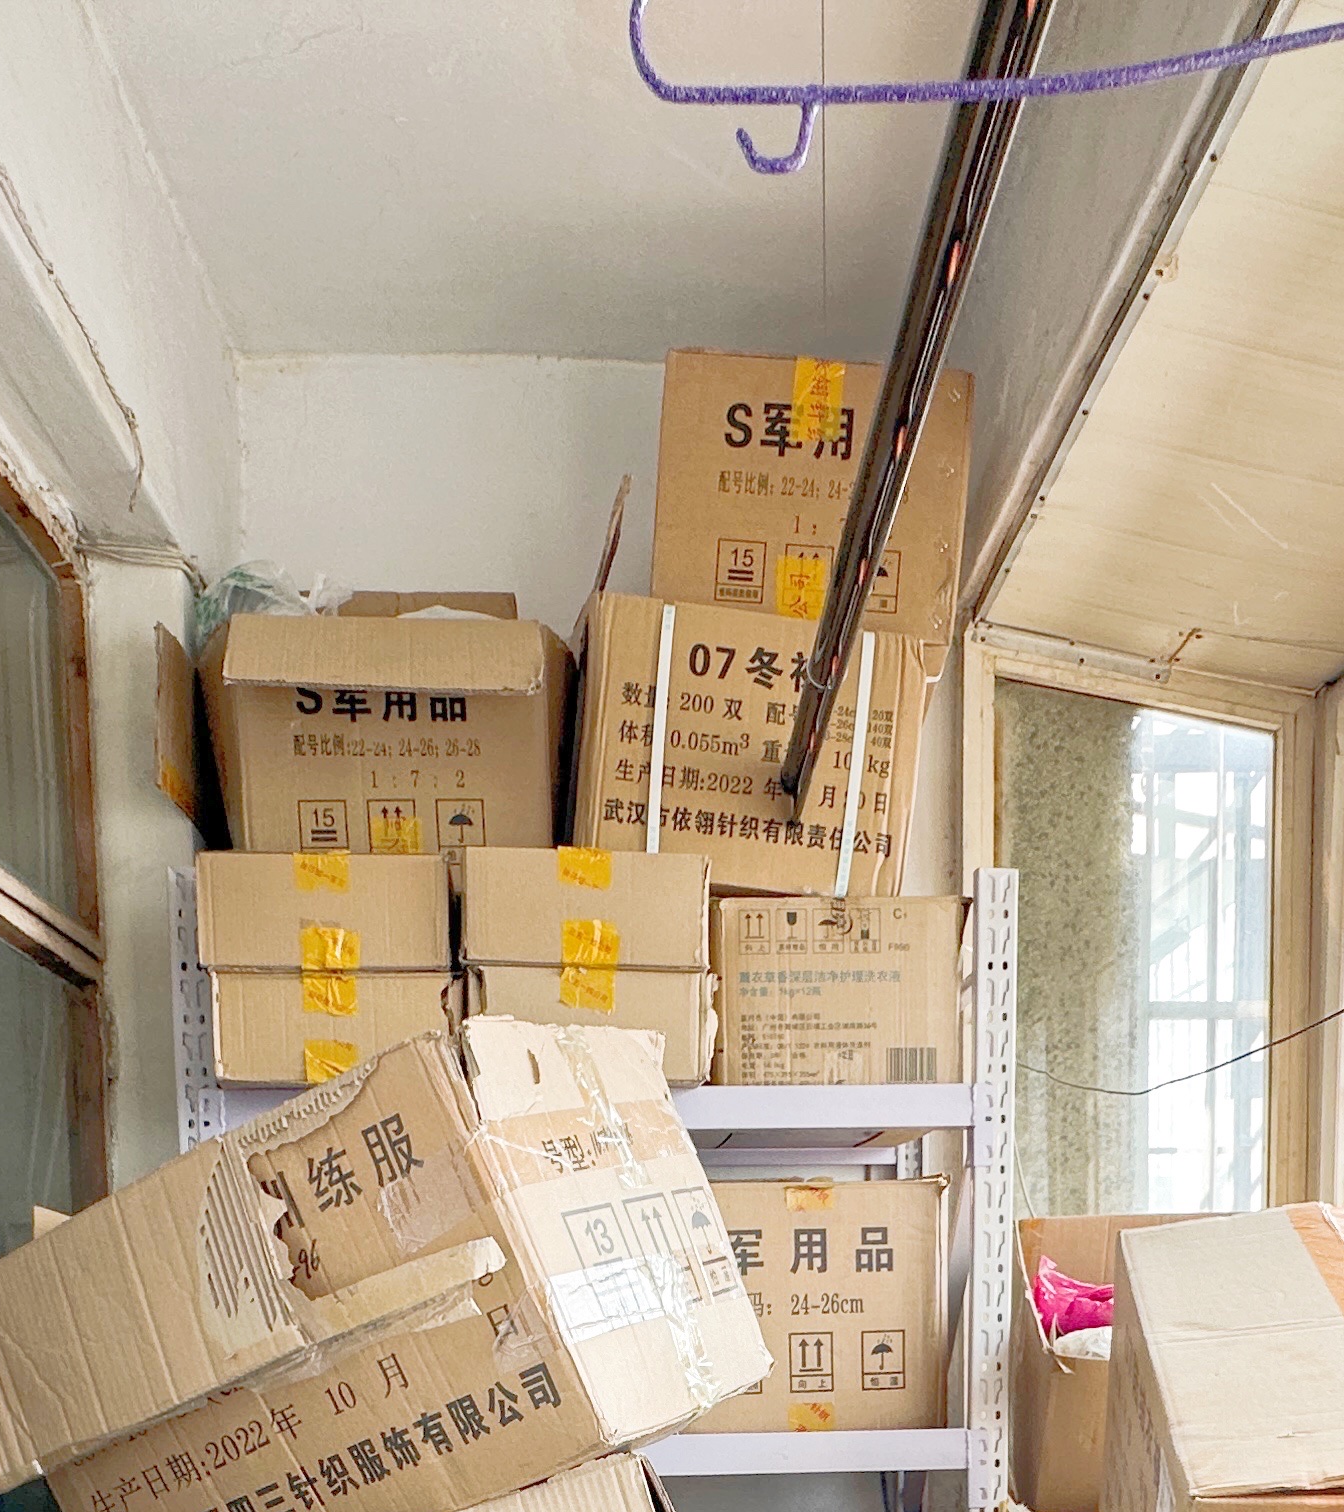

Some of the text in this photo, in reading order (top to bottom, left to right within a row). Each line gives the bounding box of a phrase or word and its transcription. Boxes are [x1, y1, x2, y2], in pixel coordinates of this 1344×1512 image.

[731, 547, 754, 567] 15
[680, 692, 715, 715] 200
[722, 697, 744, 721] 双
[866, 754, 892, 780] kg
[818, 784, 836, 809] 月
[874, 792, 888, 815] 日
[312, 807, 336, 828] 15
[585, 1217, 616, 1257] 13
[790, 1293, 865, 1317] 24-26cm
